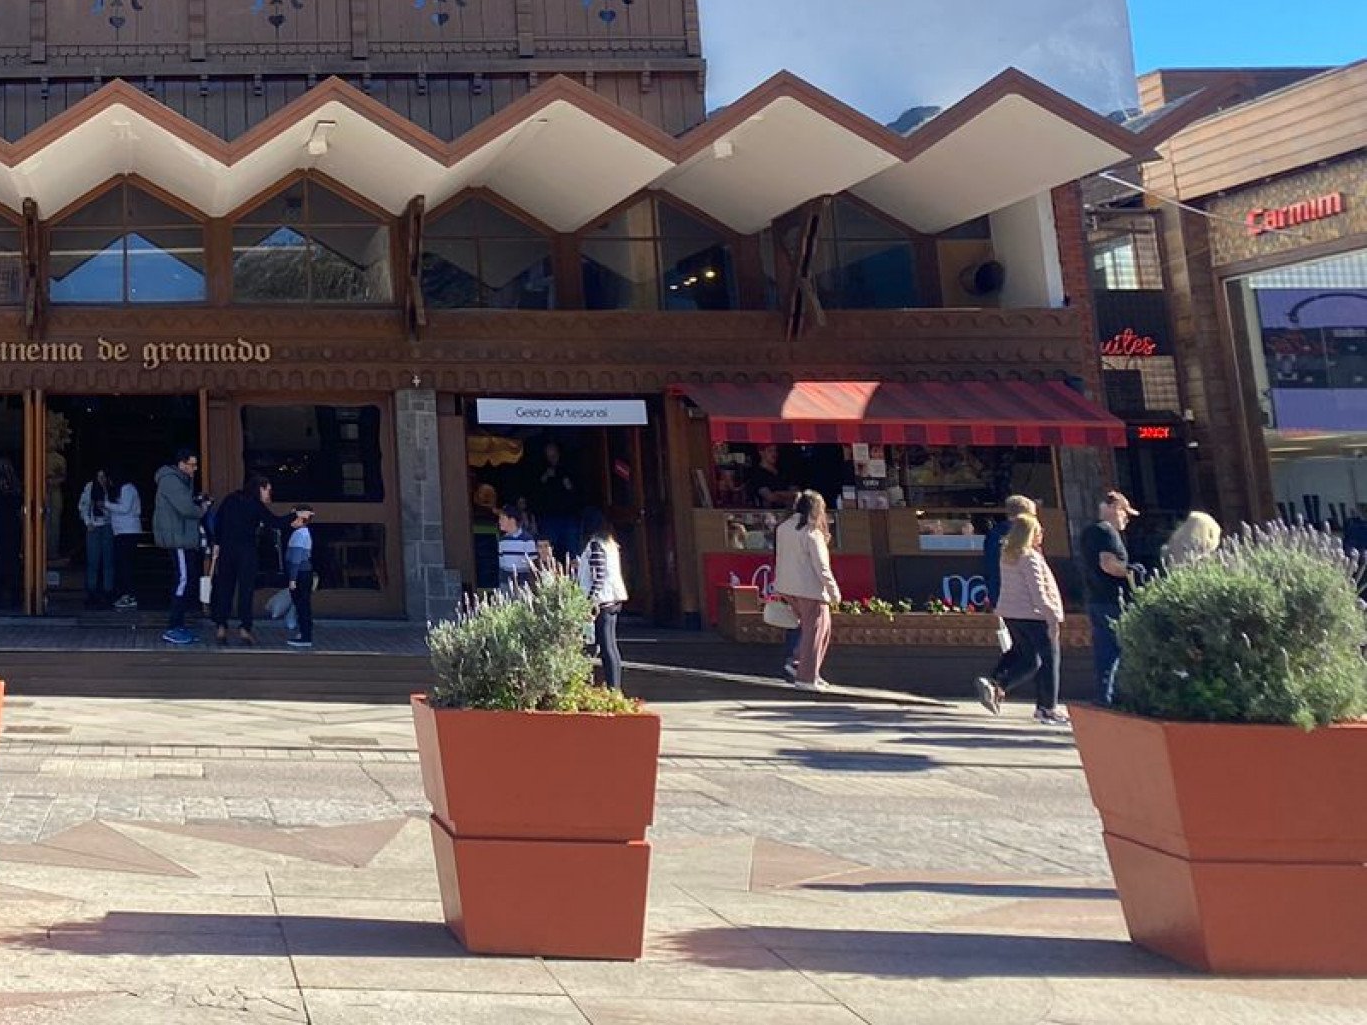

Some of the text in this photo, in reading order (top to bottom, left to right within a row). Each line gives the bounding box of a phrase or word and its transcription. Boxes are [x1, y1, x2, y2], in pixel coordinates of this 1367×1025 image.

[1245, 191, 1342, 235] Carmim
[97, 336, 130, 361] de
[142, 337, 272, 370] gramado
[515, 406, 608, 418] Gelato Artesanal
